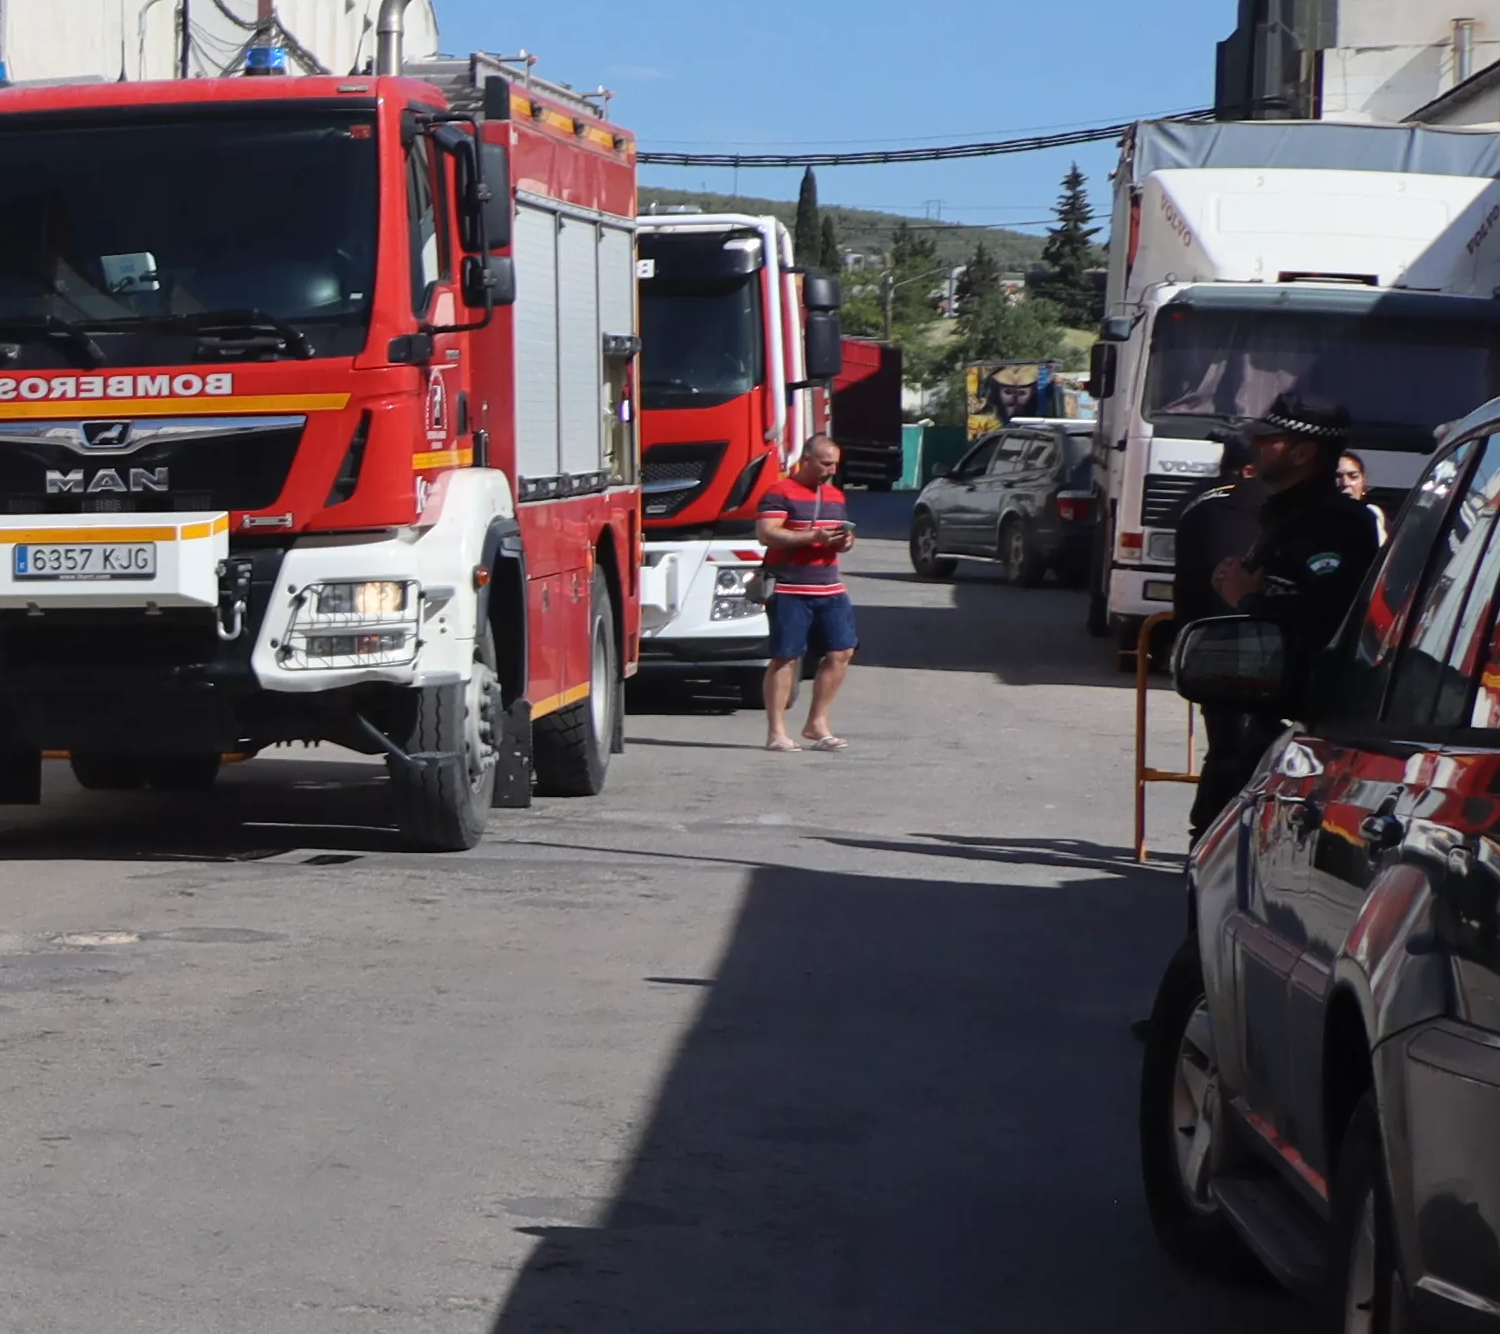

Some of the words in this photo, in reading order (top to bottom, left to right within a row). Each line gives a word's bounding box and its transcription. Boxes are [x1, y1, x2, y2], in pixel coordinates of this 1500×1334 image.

[1161, 194, 1192, 247] VOLVO
[1466, 204, 1499, 255] VOLVO
[46, 467, 169, 493] MAN
[33, 548, 93, 571] 6357
[102, 548, 148, 570] KJG
